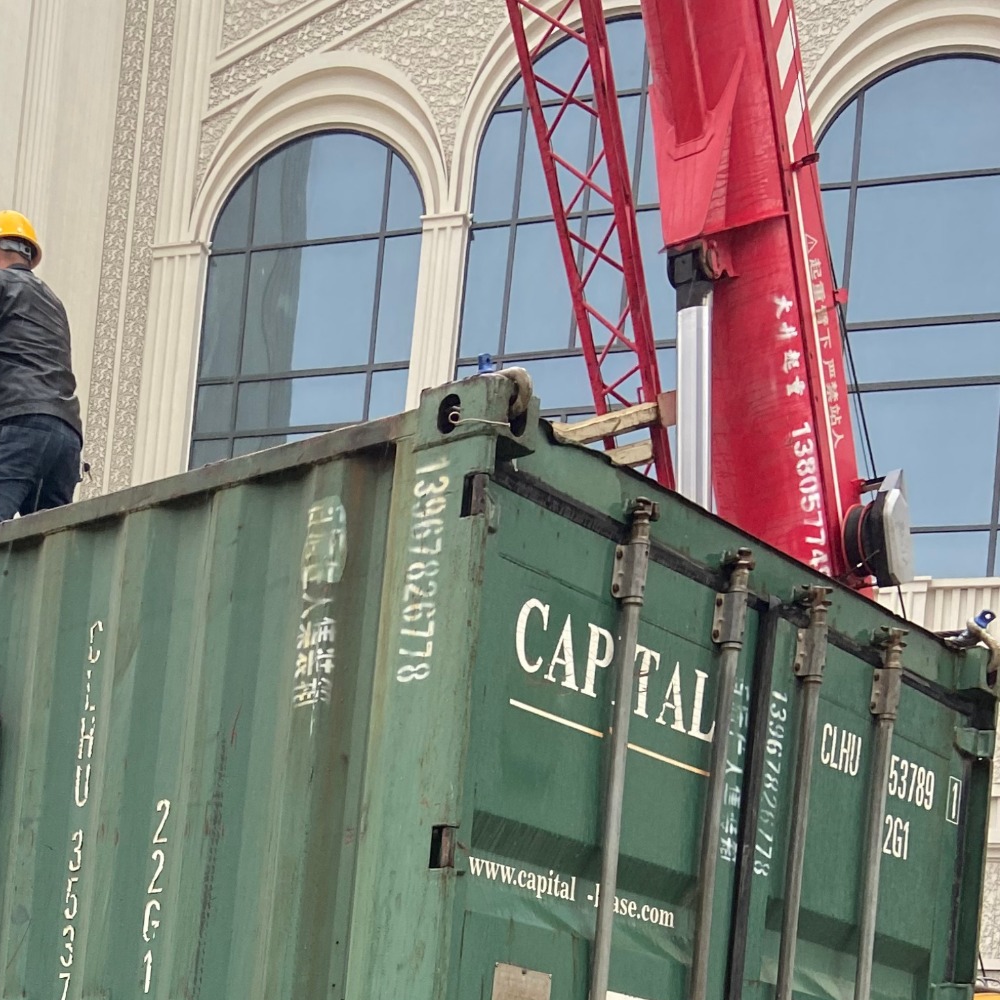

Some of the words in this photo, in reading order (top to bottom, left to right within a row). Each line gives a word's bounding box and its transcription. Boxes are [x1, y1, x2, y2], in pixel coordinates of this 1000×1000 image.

[822, 358, 844, 449] 严禁站人
[396, 456, 450, 683] 13967826778
[515, 598, 716, 743] CAPTAL
[820, 723, 862, 776] CLHU
[142, 799, 170, 993] 22G1
